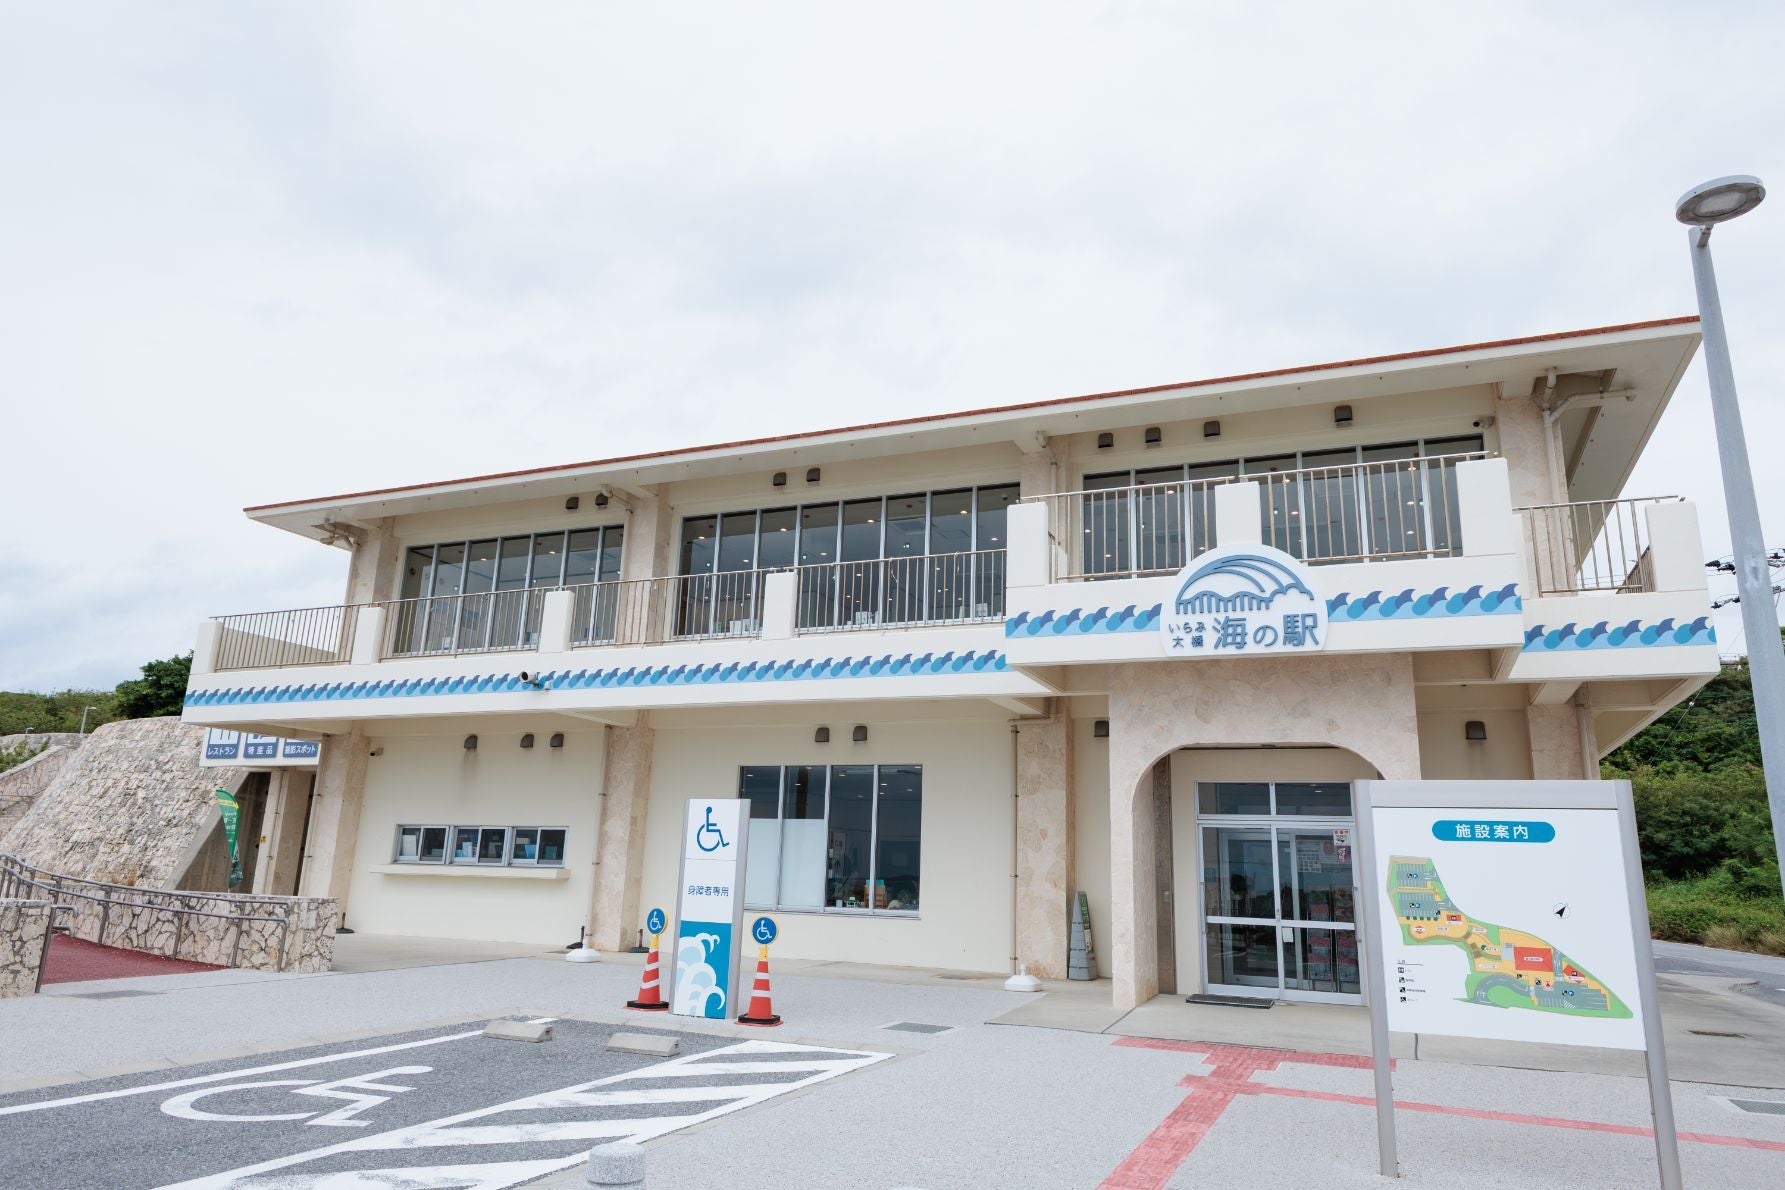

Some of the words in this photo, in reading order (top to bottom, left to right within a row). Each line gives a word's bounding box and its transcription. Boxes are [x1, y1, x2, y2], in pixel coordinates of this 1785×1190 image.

[1212, 612, 1320, 650] 海の駅
[1172, 635, 1204, 648] 大橋
[207, 746, 236, 756] レストラン
[247, 745, 273, 755] 特産品
[284, 744, 316, 755] 撮影スポット
[1455, 823, 1530, 840] 施設案内
[687, 885, 729, 897] 身障者専用
